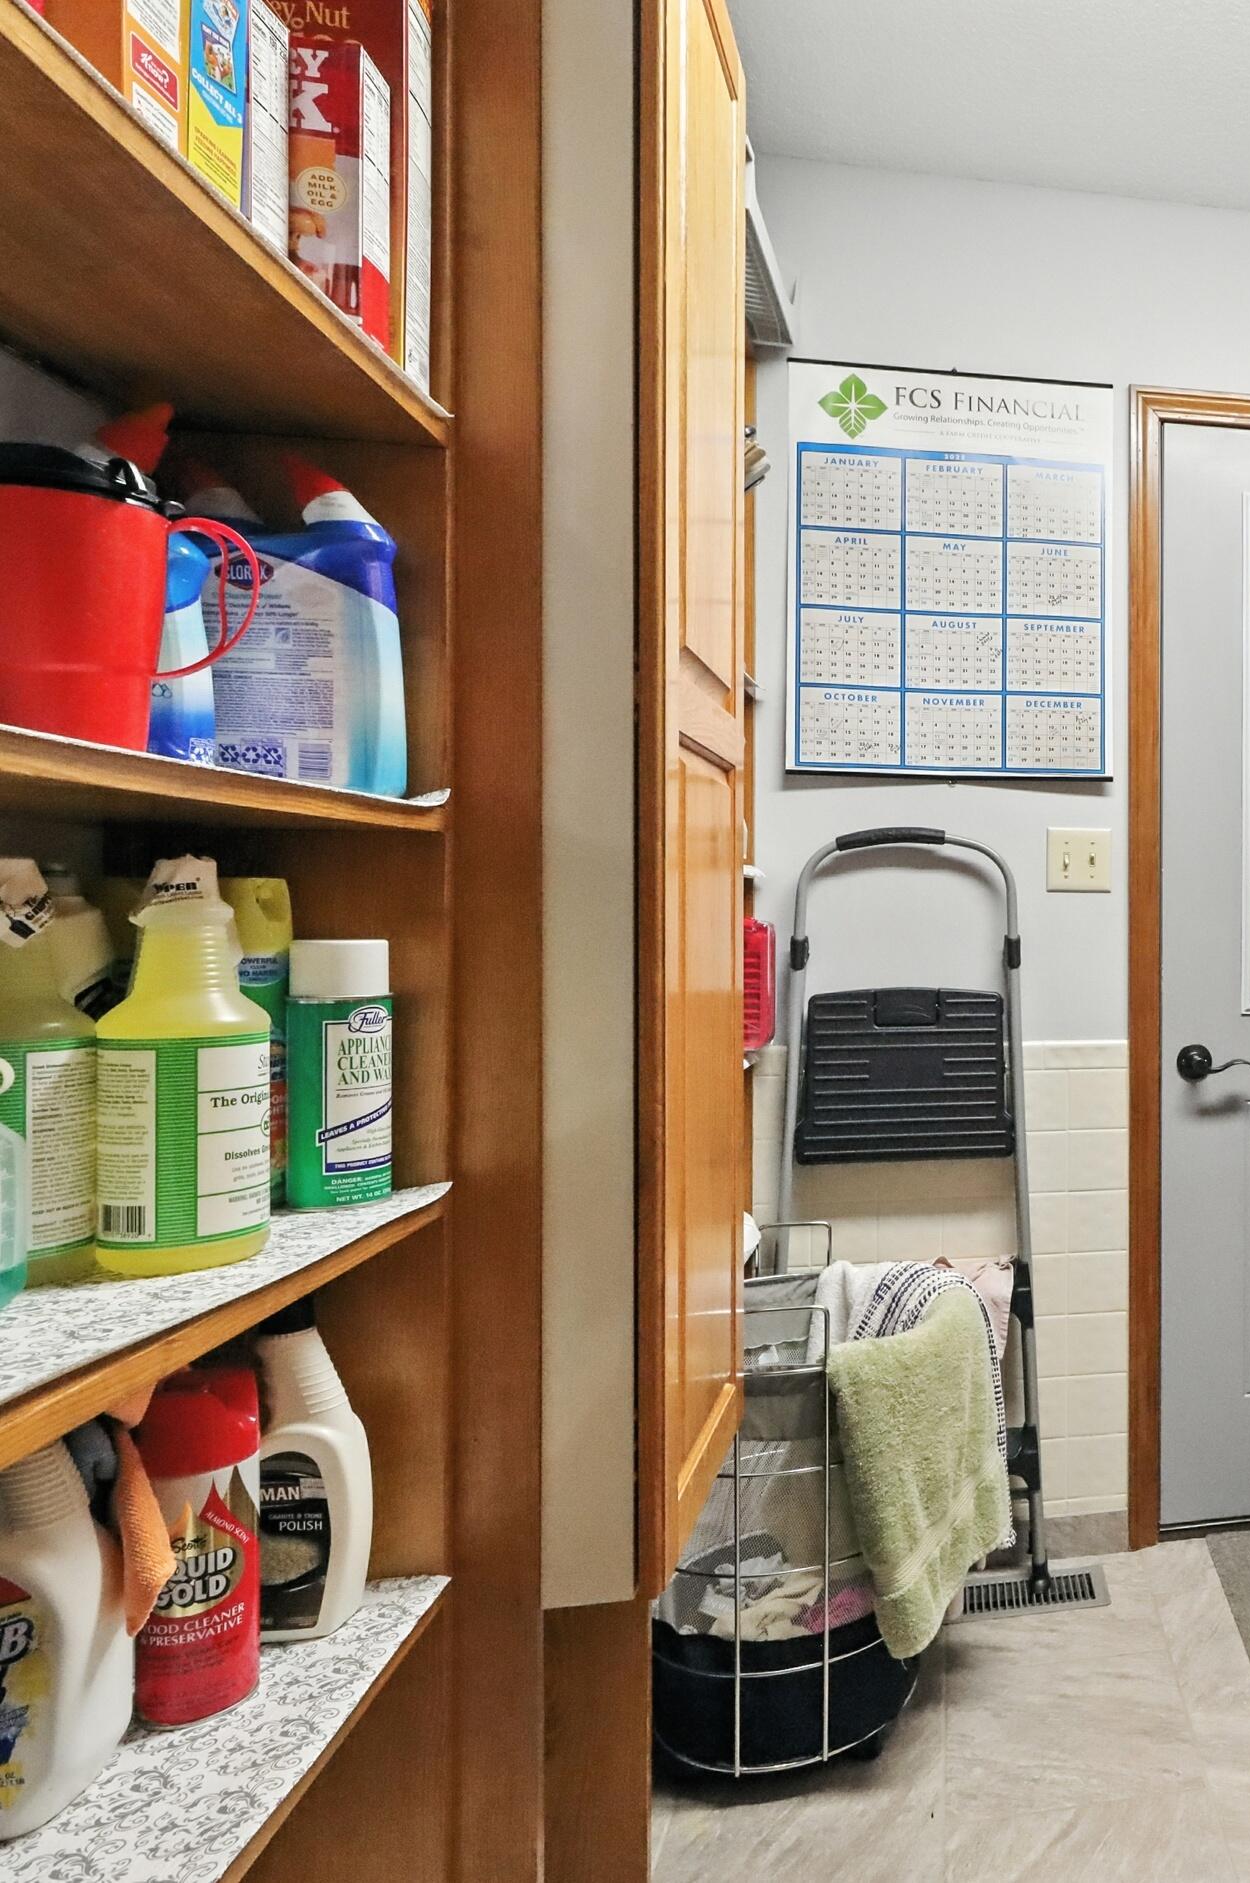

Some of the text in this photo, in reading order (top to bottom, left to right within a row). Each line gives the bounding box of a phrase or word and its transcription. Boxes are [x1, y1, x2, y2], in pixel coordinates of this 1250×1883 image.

[310, 174, 334, 183] ADD
[307, 190, 325, 198] OIL
[310, 199, 333, 208] EGG
[895, 386, 942, 409] FCS
[893, 411, 929, 425] Growing
[987, 418, 1021, 431] Creating
[824, 457, 879, 468] JANUARY
[926, 464, 983, 475] FEBRUARY
[834, 536, 869, 545] APRIL
[943, 543, 966, 551] MAY
[1040, 548, 1069, 557] JUNE
[837, 615, 865, 624] JULY
[932, 620, 977, 629] AUGUST
[1024, 623, 1085, 633] SEPTEMBER
[824, 692, 878, 703] OCTOBER
[923, 697, 985, 706] NOVEMBER
[1026, 700, 1082, 709] DECEMBER
[349, 1010, 388, 1033] Fuller
[337, 1052, 391, 1071] CLEANE
[338, 1070, 370, 1086] AND
[210, 1094, 238, 1109] The
[320, 1126, 348, 1140] LEAVES
[224, 1148, 260, 1161] Dissolves
[336, 1195, 350, 1203] NET
[260, 1485, 300, 1502] MAN
[206, 1511, 250, 1544] ALMOND SCENT
[279, 1520, 323, 1532] POLISH
[171, 1547, 234, 1582] QUID
[146, 1602, 246, 1636] OOD CLEANER
[150, 1614, 243, 1647] PRESERVATIVE
